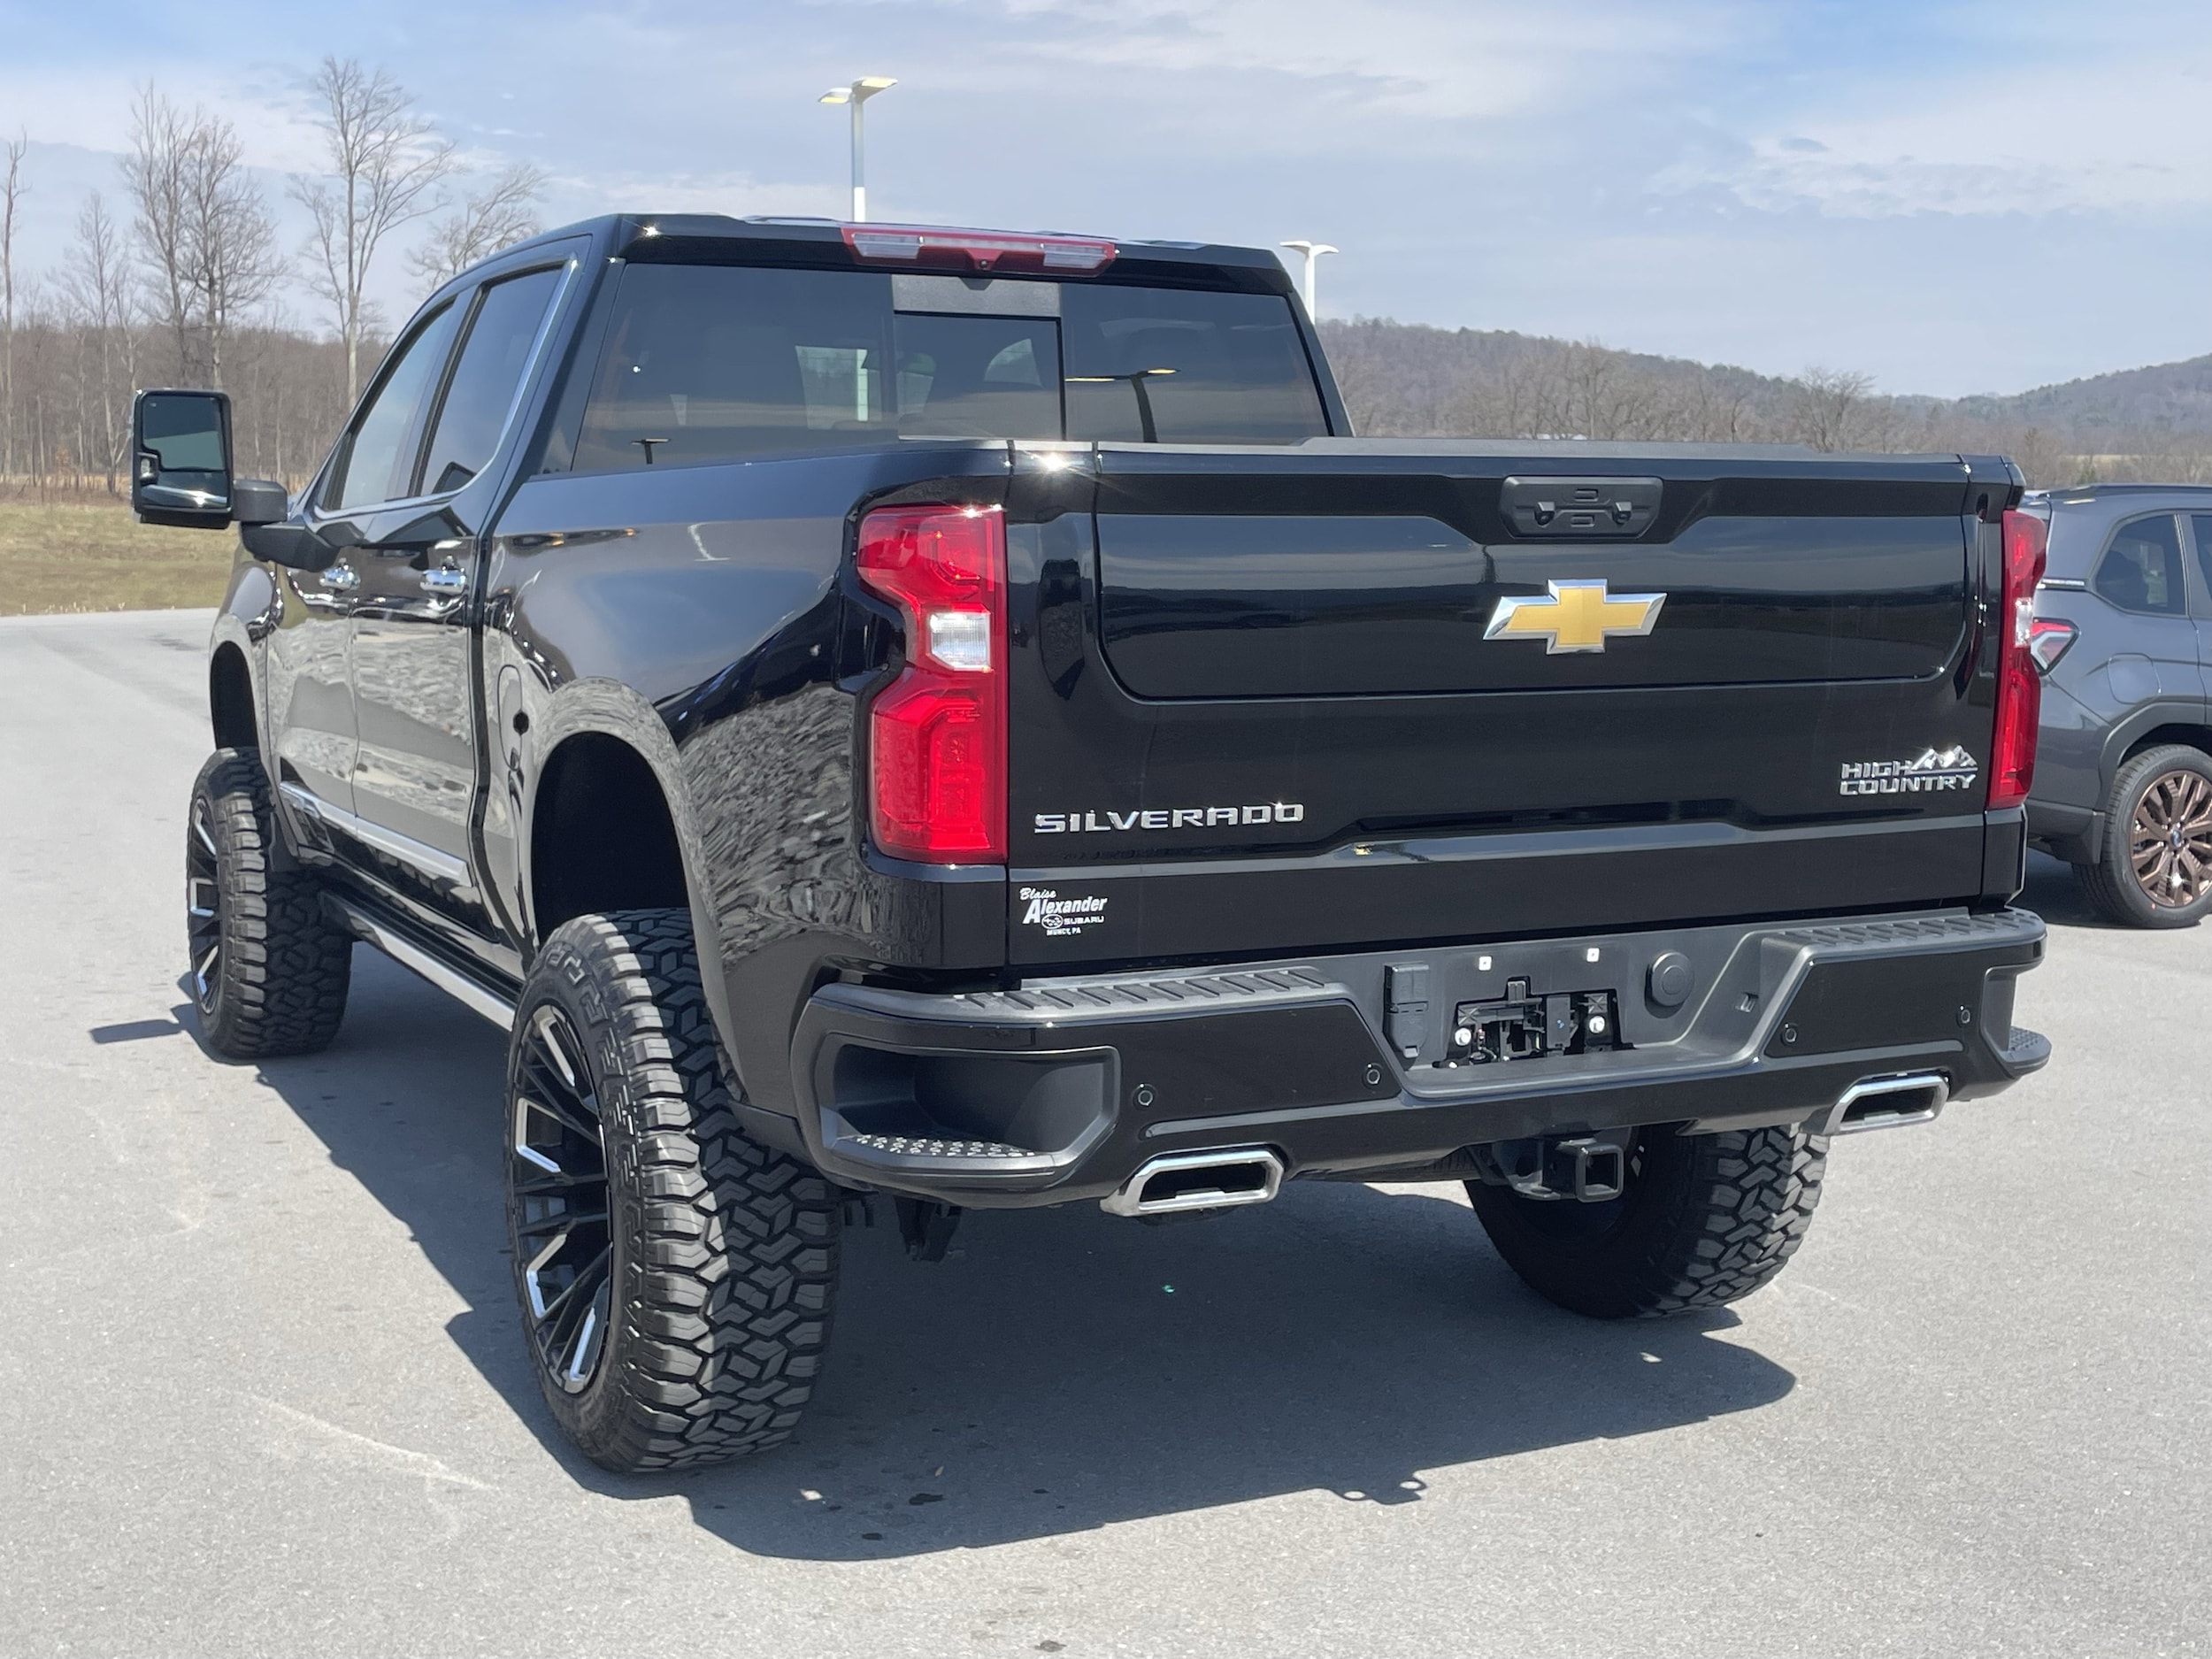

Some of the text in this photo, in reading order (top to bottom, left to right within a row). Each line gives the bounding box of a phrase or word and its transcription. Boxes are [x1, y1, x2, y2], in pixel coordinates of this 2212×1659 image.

[1841, 761, 1913, 779] HIGH
[1839, 774, 1977, 795] COUNTRY
[1033, 803, 1304, 833] SILVERADO
[1019, 887, 1056, 900] Blaise
[1022, 896, 1108, 924] Alexander
[1064, 916, 1104, 925] SUBARU
